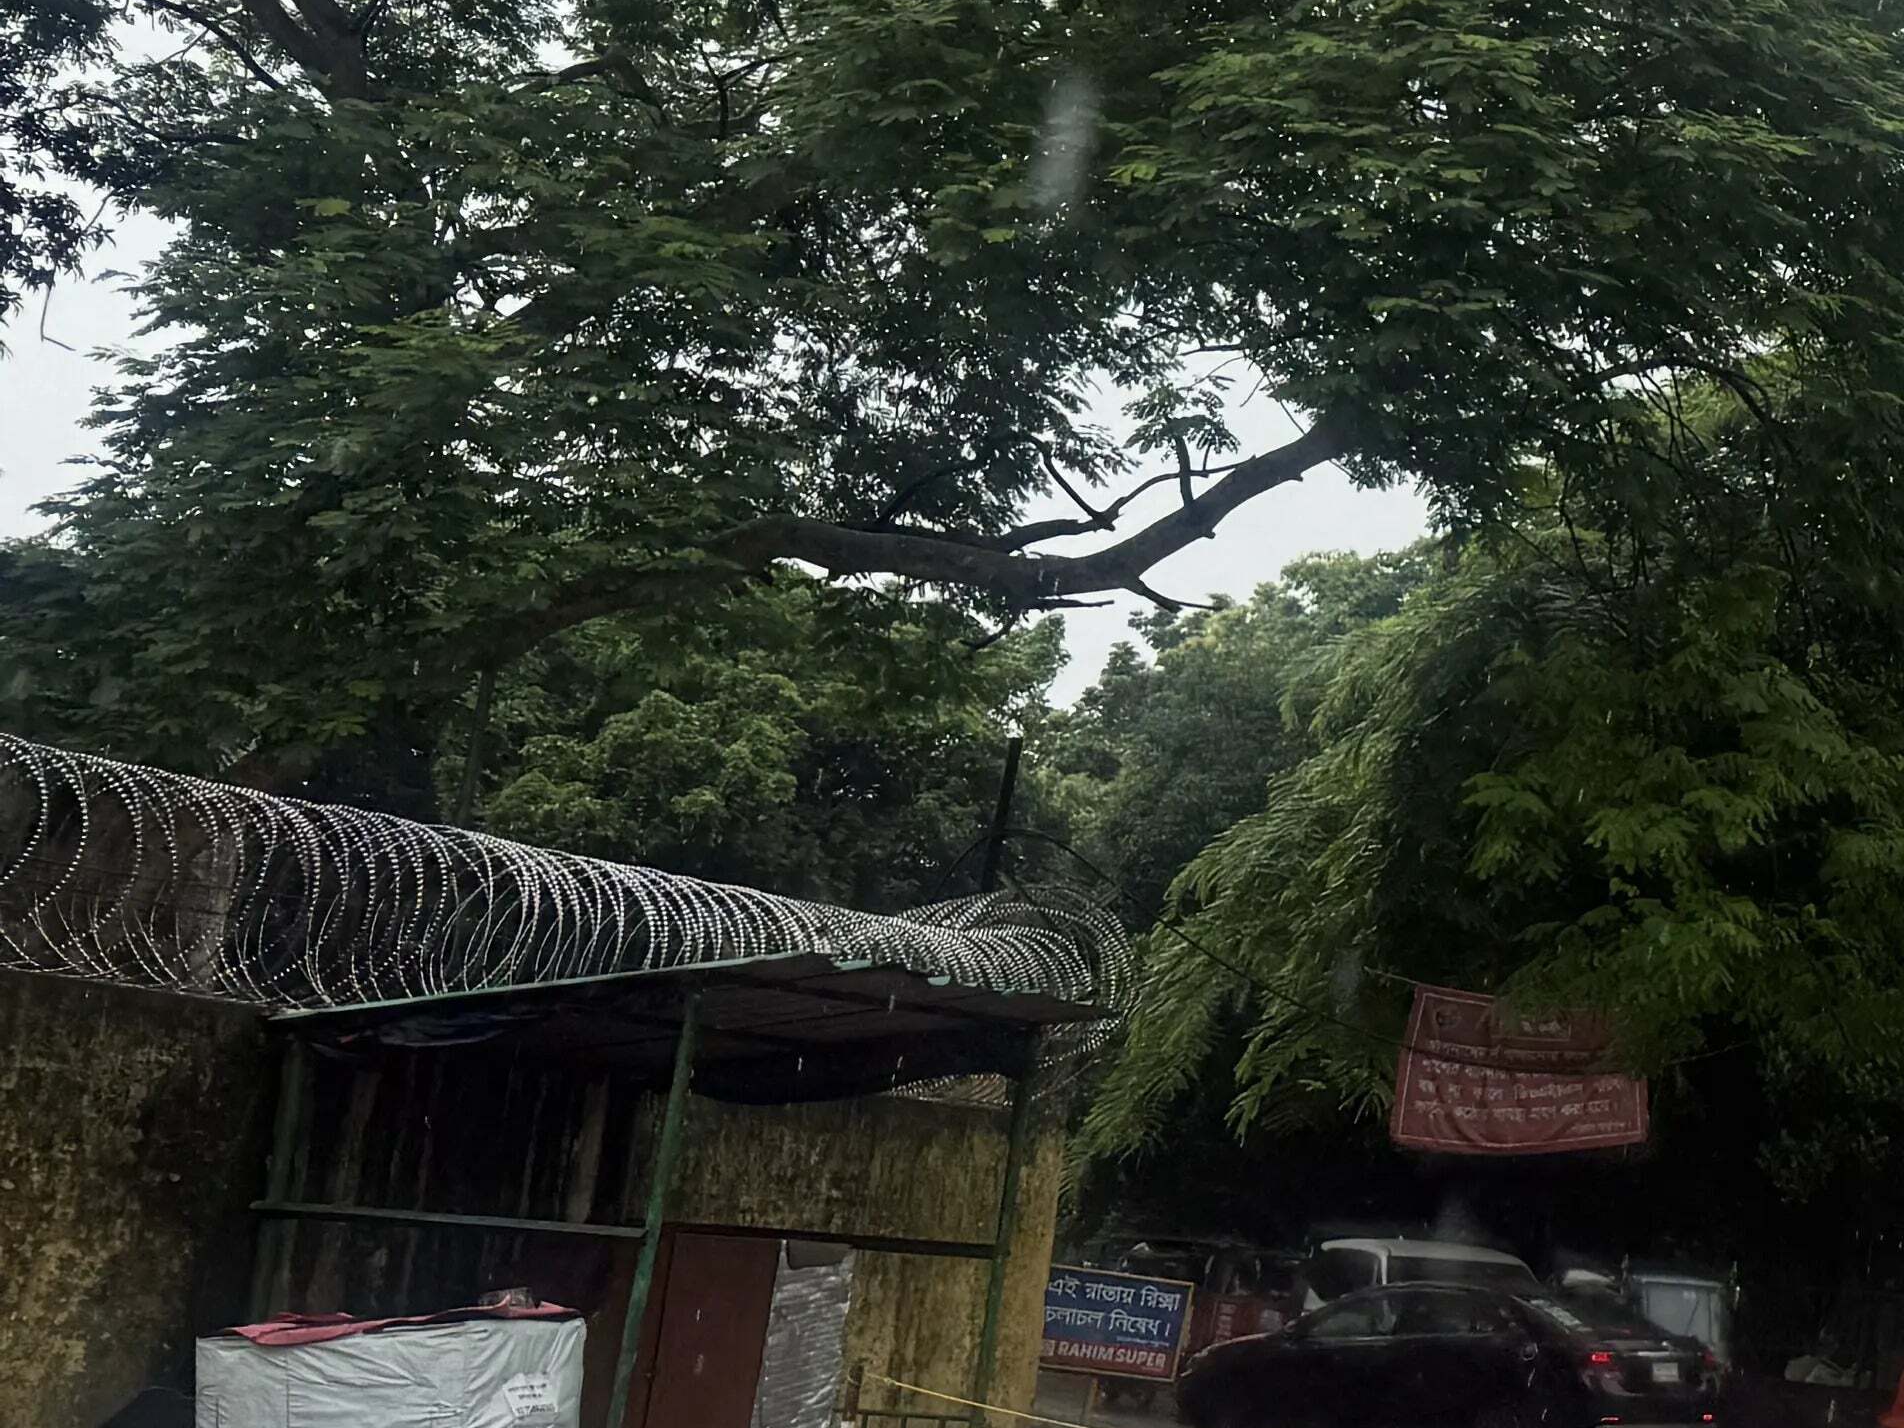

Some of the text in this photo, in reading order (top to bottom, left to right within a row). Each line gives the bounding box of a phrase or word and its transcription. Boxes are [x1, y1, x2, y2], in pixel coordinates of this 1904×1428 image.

[1048, 1275, 1081, 1299] এই
[1044, 1305, 1105, 1329] চলাচল
[1056, 1340, 1114, 1362] RAHIM
[1114, 1348, 1167, 1369] SUPER
